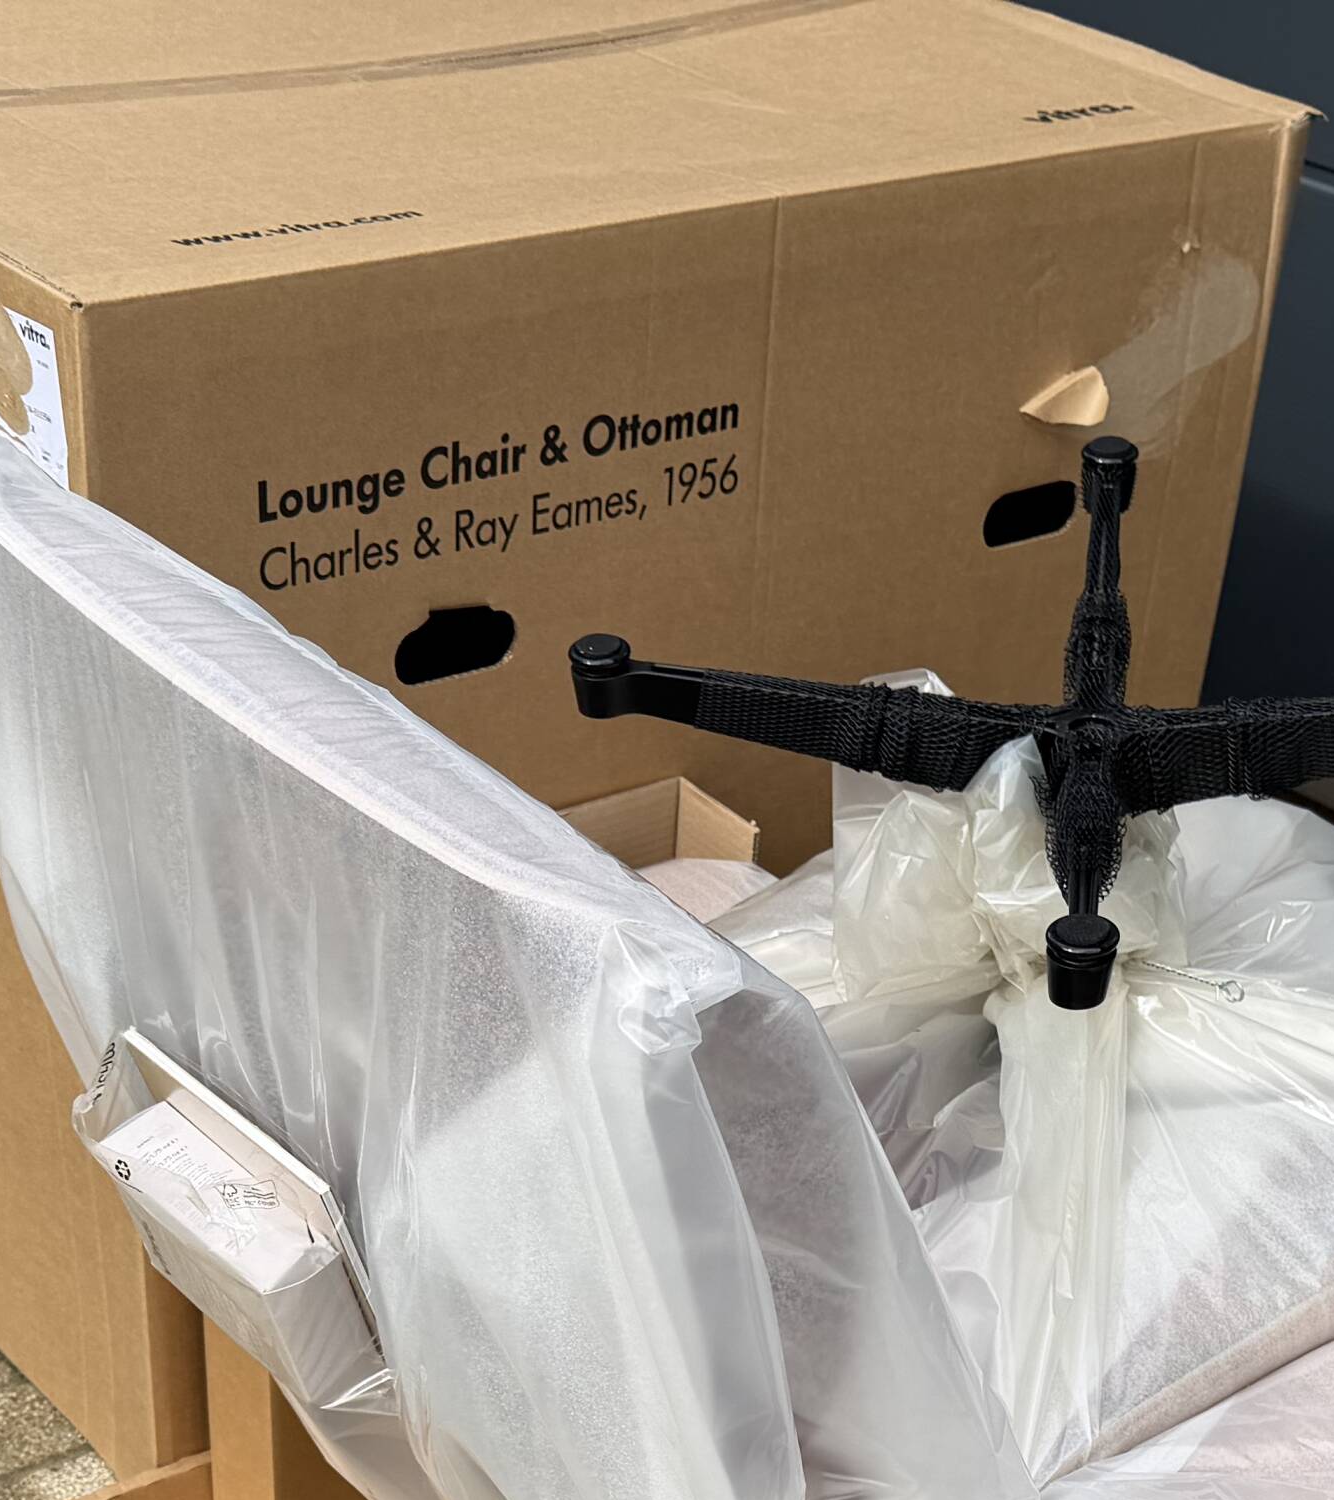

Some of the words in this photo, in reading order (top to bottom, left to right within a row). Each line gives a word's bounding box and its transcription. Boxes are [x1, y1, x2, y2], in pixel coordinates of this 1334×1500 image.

[171, 212, 422, 246] www.vitra.com
[258, 469, 405, 523] Lounge
[421, 433, 526, 489] Chair
[540, 425, 568, 466] &
[583, 404, 738, 456] Ottoman
[260, 529, 398, 590] Charles
[414, 517, 440, 559] &
[456, 511, 518, 552] Ray
[533, 489, 646, 534] Eames,
[664, 454, 738, 506] 1956
